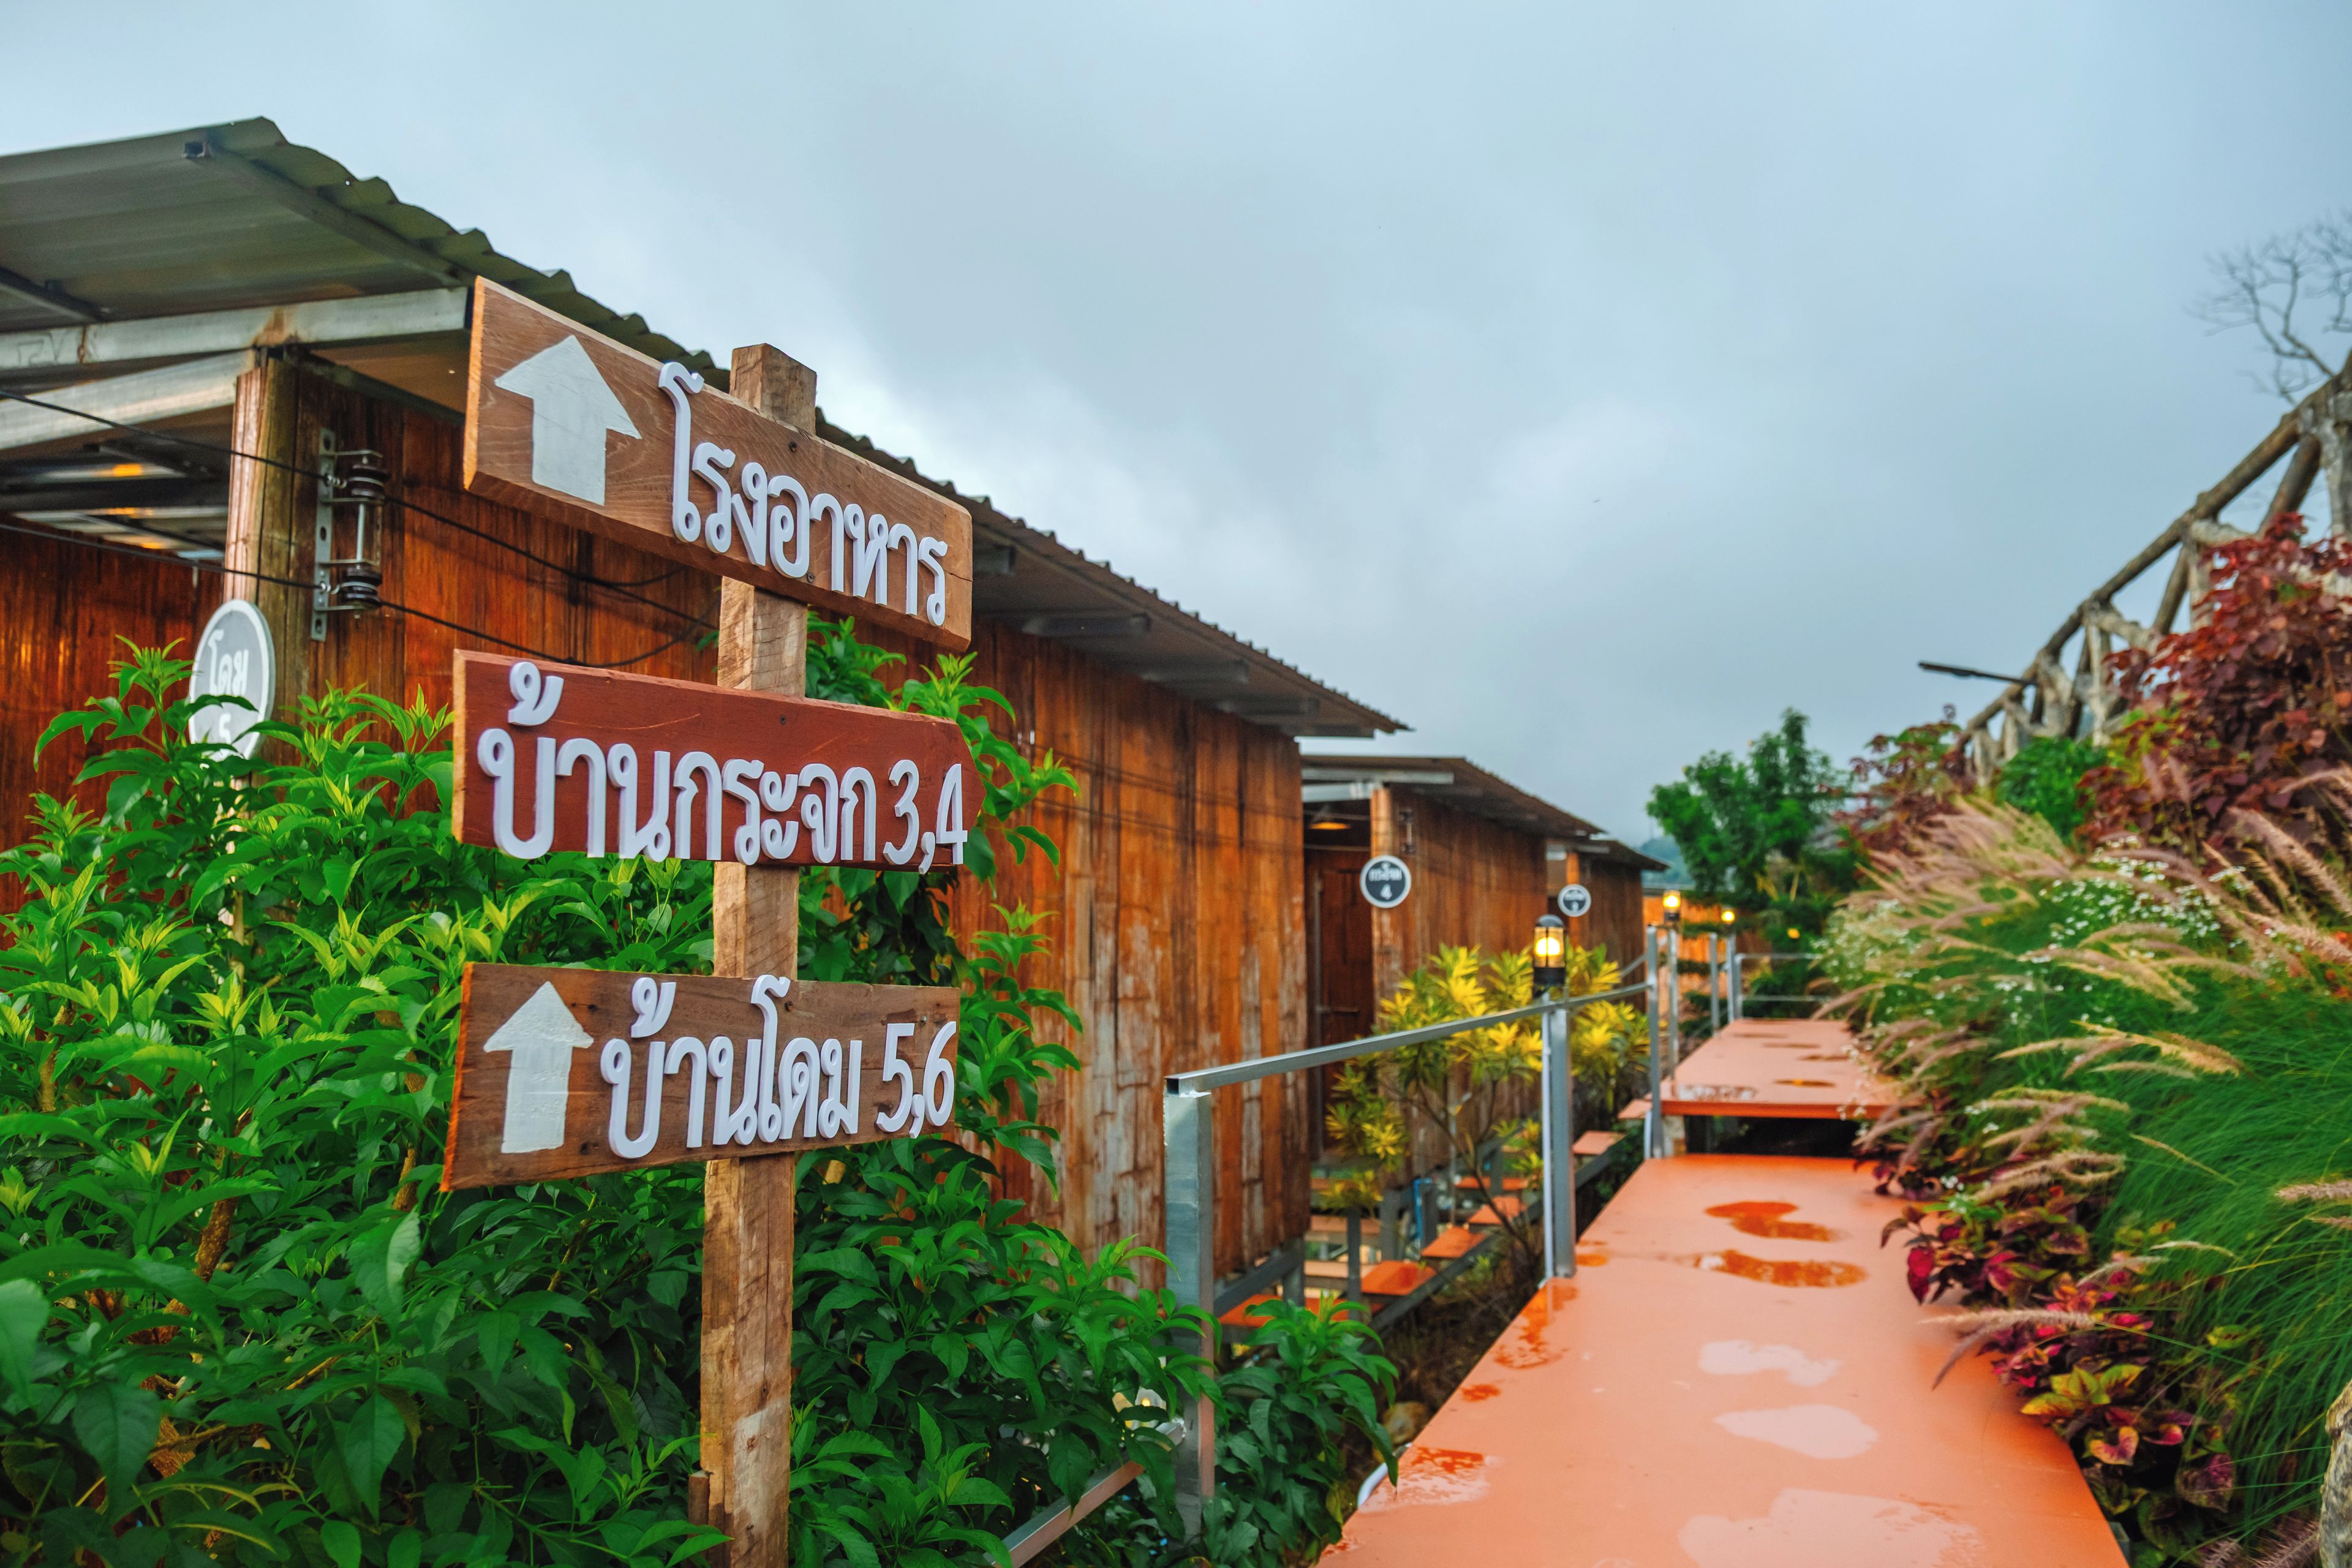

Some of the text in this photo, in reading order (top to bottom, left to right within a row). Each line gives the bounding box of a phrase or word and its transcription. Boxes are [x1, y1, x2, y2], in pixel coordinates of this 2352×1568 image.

[658, 362, 948, 627] โรงอาหาร
[477, 661, 968, 875] บ้านกระจก 3,4
[600, 974, 957, 1159] บ้านโดม 5,6
